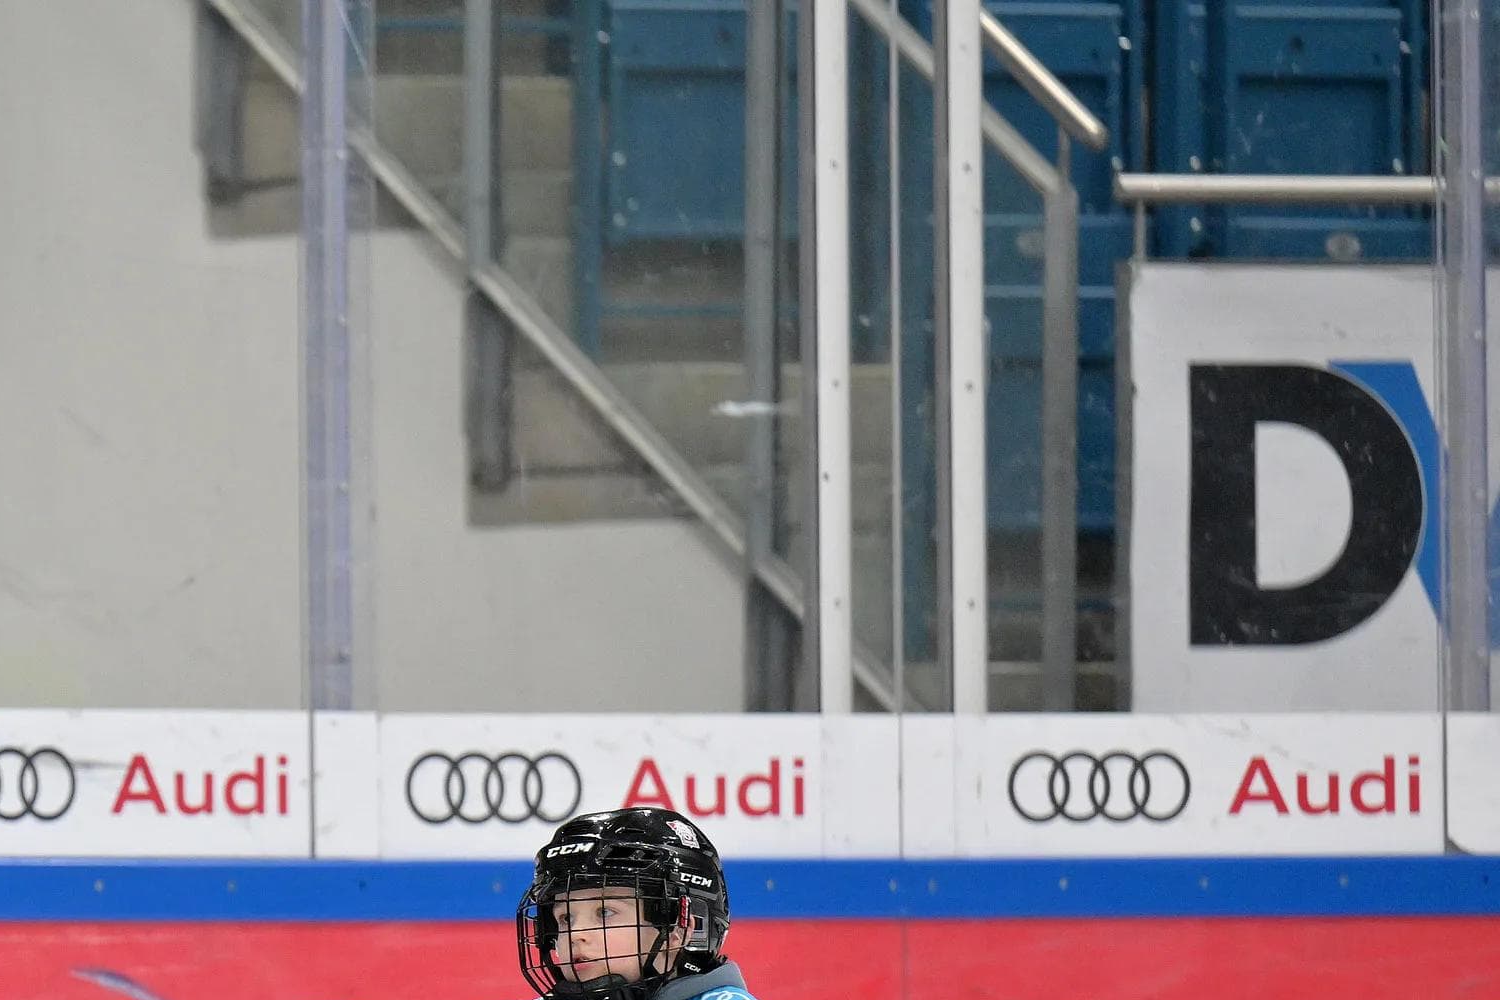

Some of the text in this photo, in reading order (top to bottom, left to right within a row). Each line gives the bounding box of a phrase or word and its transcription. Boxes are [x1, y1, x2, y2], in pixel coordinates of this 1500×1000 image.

[111, 754, 290, 816] Audi
[621, 758, 805, 817] Audi
[1229, 755, 1421, 815] Audi
[546, 842, 595, 858] CCM
[680, 872, 713, 888] CCM
